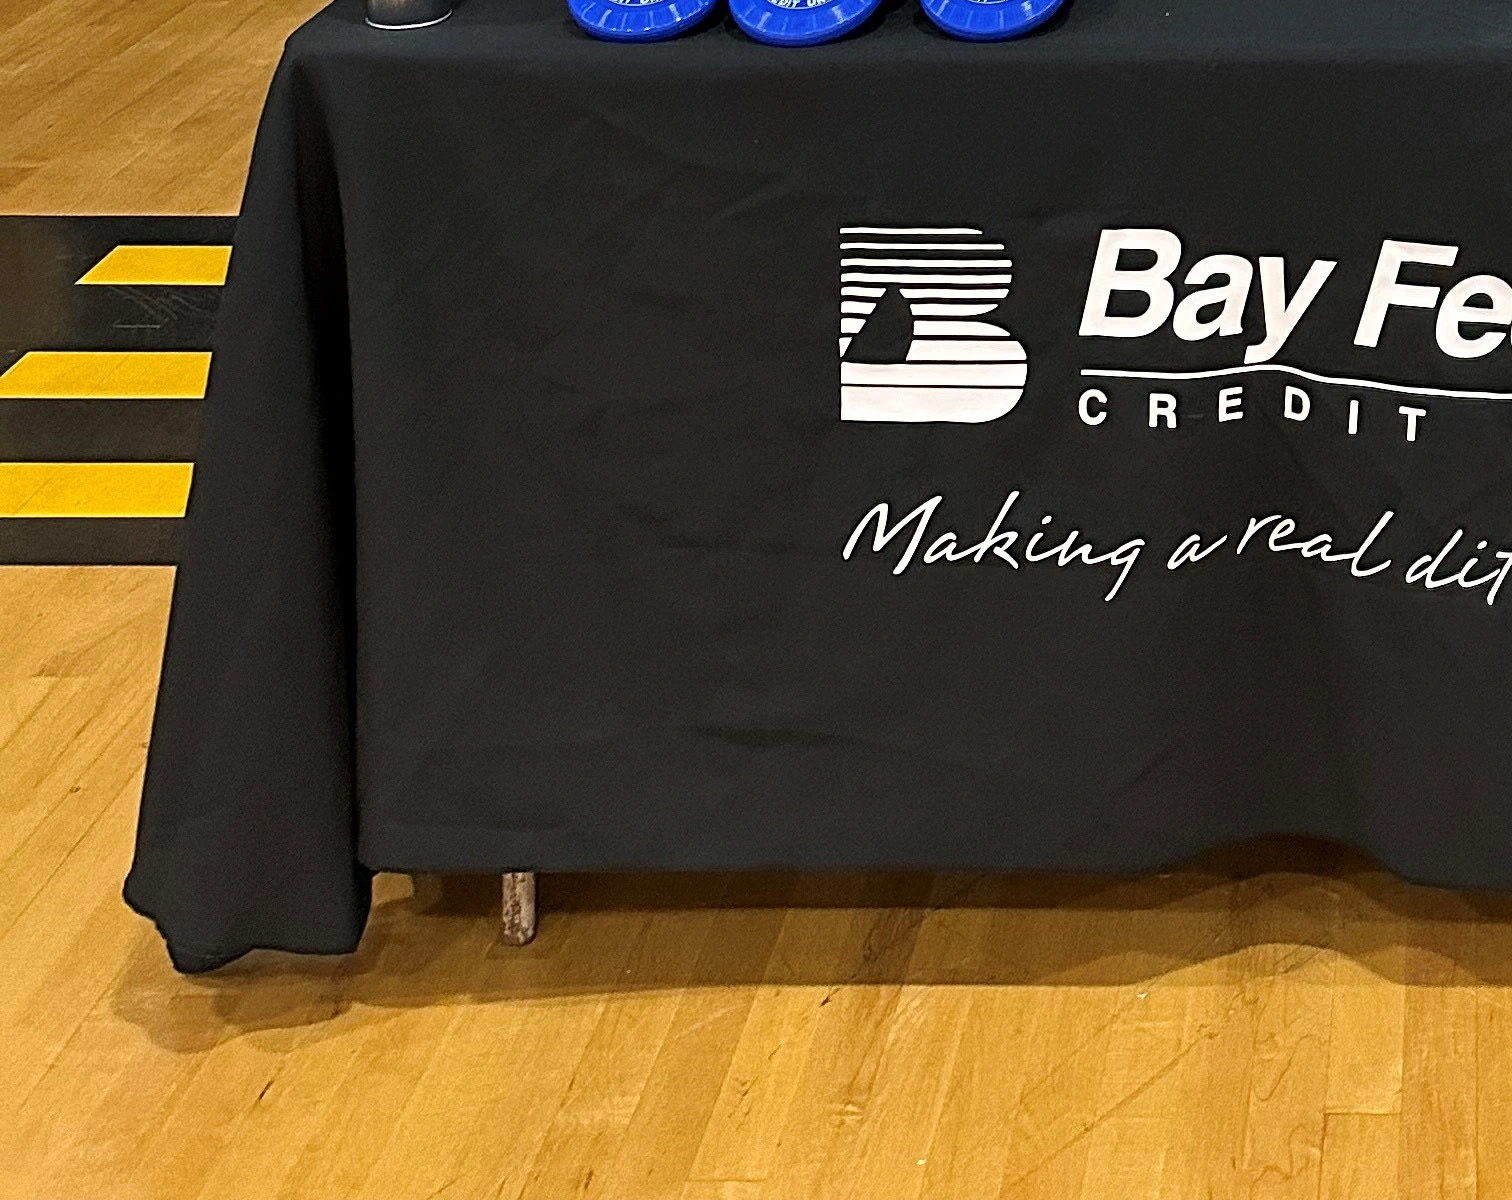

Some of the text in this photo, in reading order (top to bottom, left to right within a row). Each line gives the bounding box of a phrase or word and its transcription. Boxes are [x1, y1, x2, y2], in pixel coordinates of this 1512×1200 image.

[1078, 228, 1338, 365] Bay
[1078, 385, 1427, 442] CREDIT
[842, 490, 1146, 602] Making
[1166, 534, 1228, 570] a
[1236, 510, 1396, 576] real
